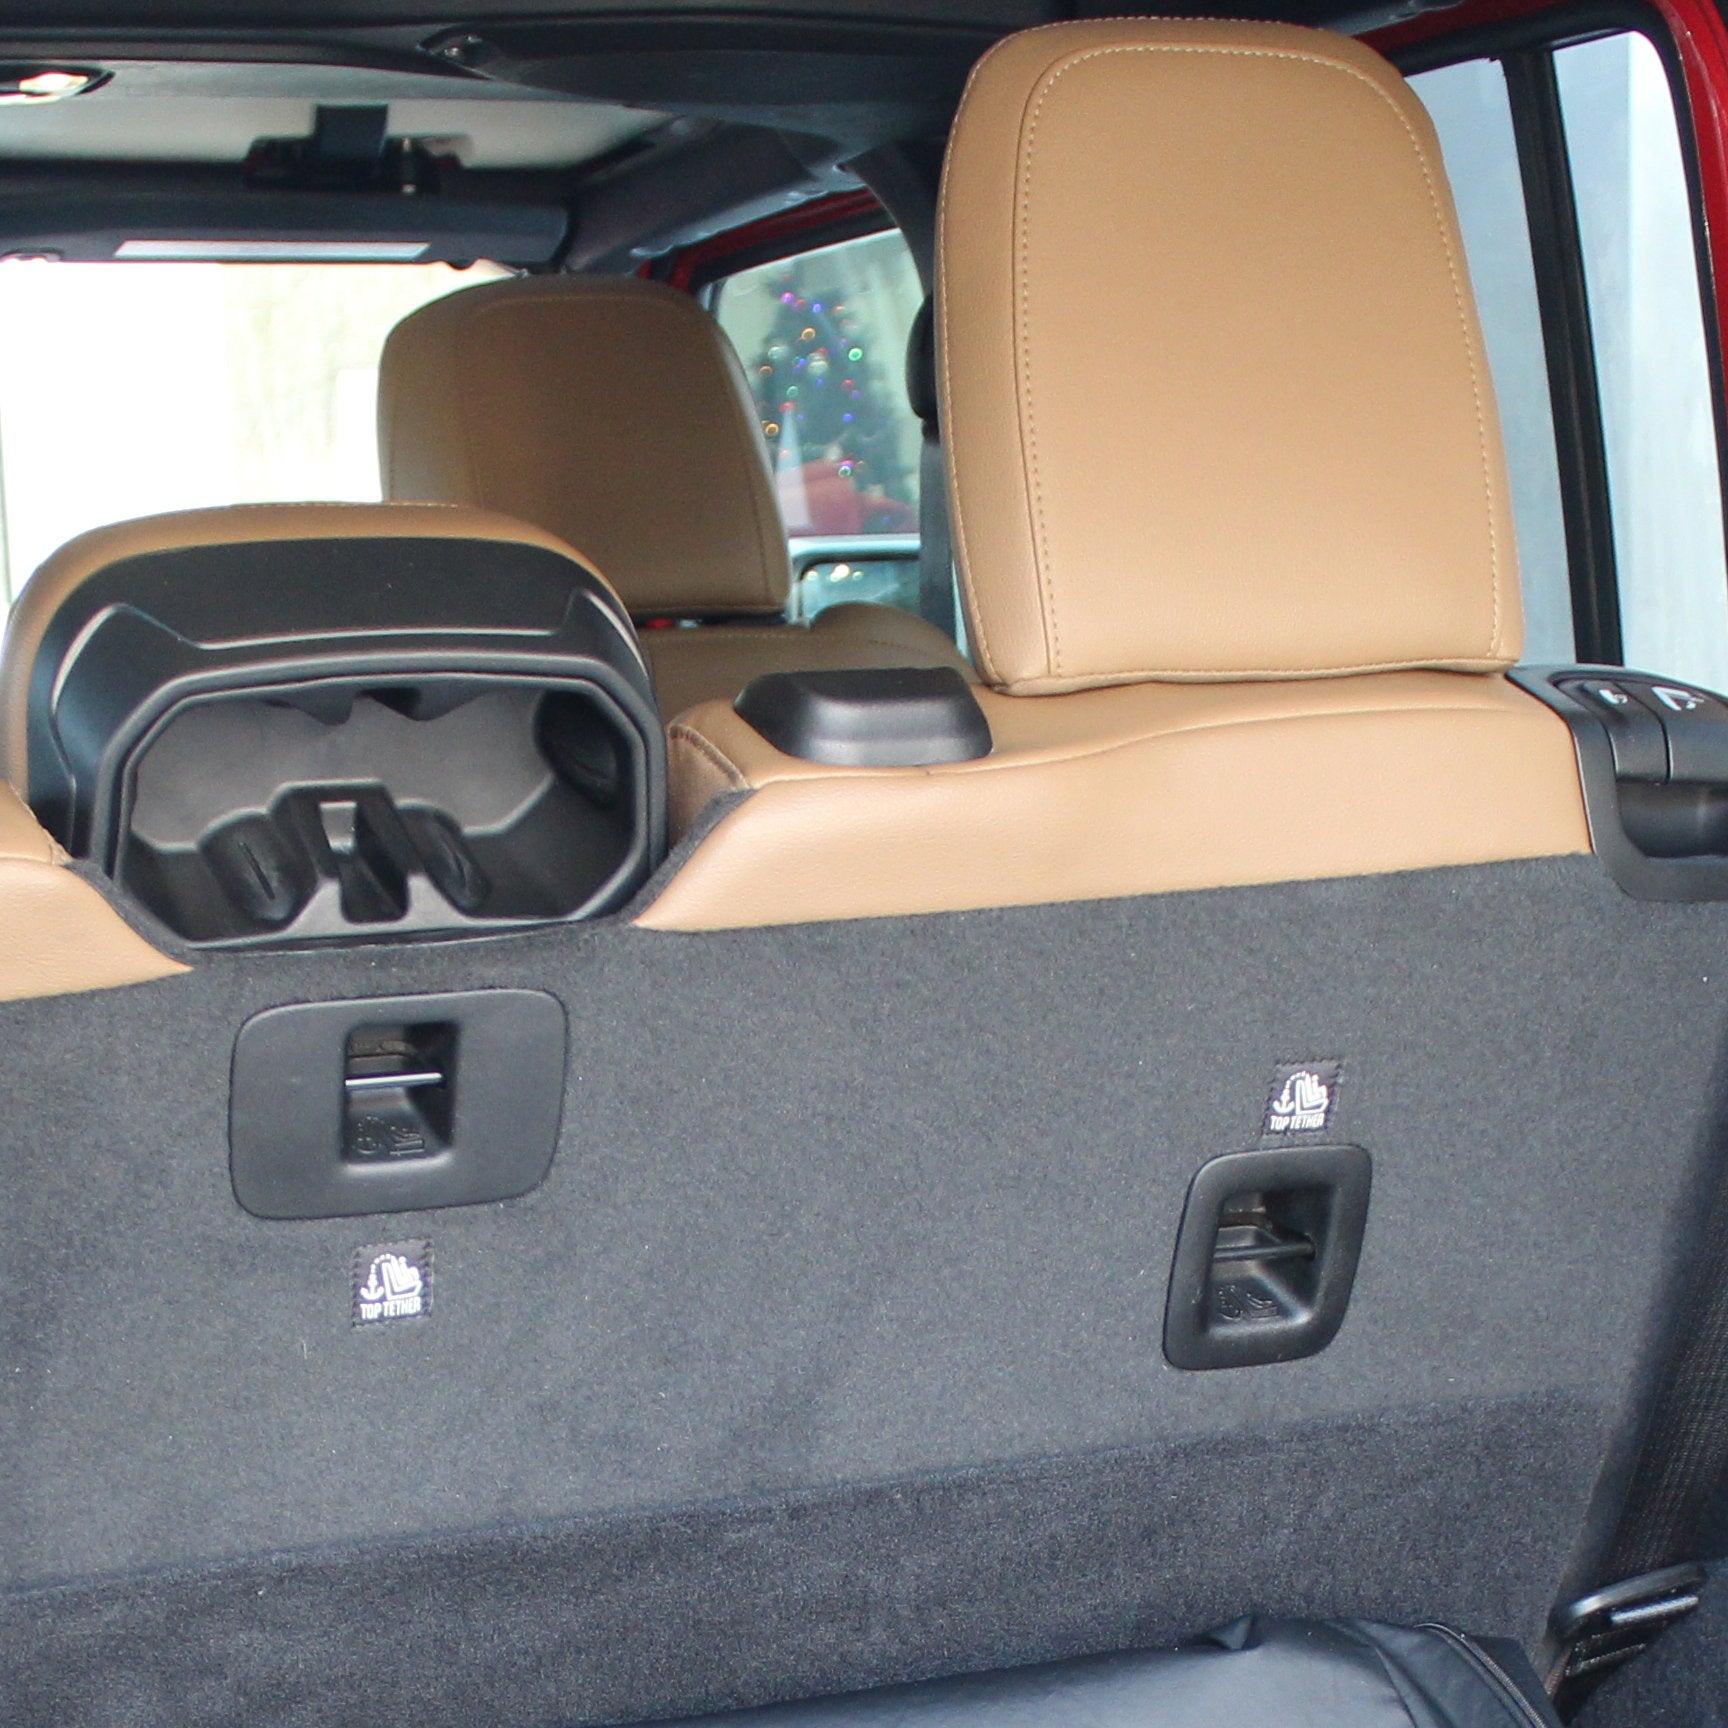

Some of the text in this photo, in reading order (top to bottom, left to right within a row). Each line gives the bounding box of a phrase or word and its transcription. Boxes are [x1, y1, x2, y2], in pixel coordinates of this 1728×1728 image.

[1270, 1112, 1325, 1131] TOP TETHER
[359, 1296, 421, 1319] TOP TETHER
